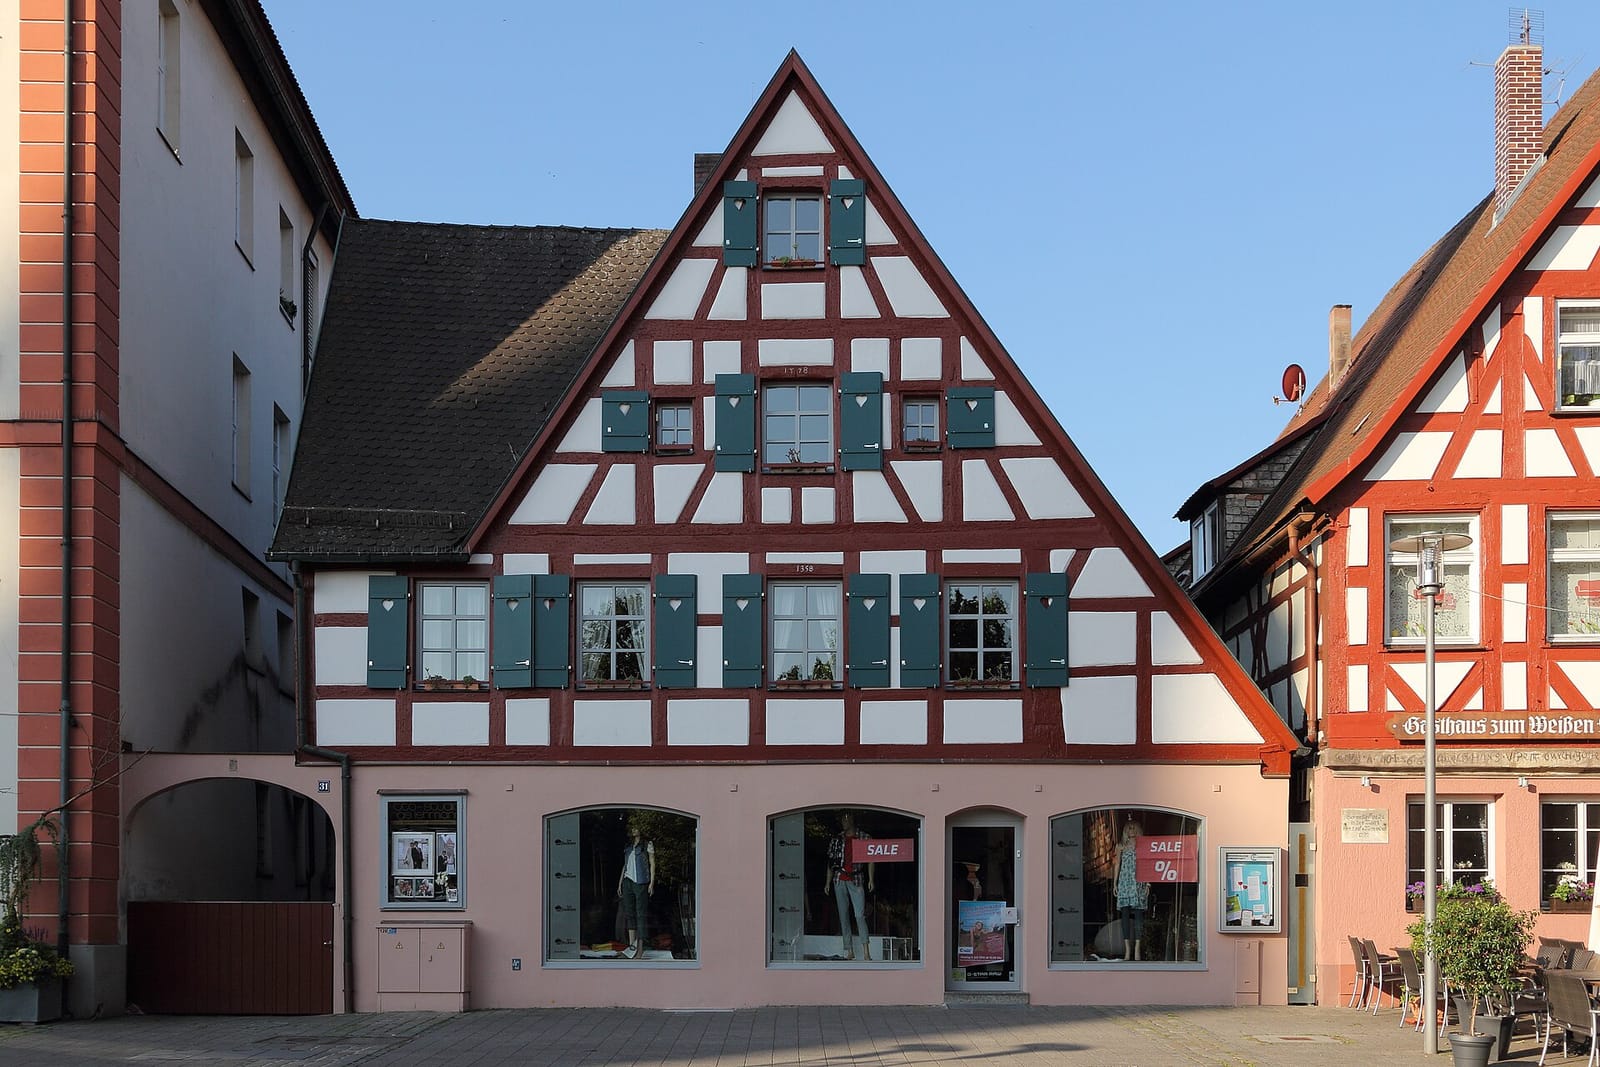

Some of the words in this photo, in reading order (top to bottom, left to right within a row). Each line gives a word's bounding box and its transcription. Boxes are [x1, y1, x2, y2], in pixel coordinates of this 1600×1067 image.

[1490, 718, 1526, 735] zum
[1528, 715, 1595, 736] Weißen
[319, 782, 328, 790] 31
[867, 843, 899, 856] SALE
[1150, 841, 1182, 853] SALE
[1154, 861, 1178, 881] %
